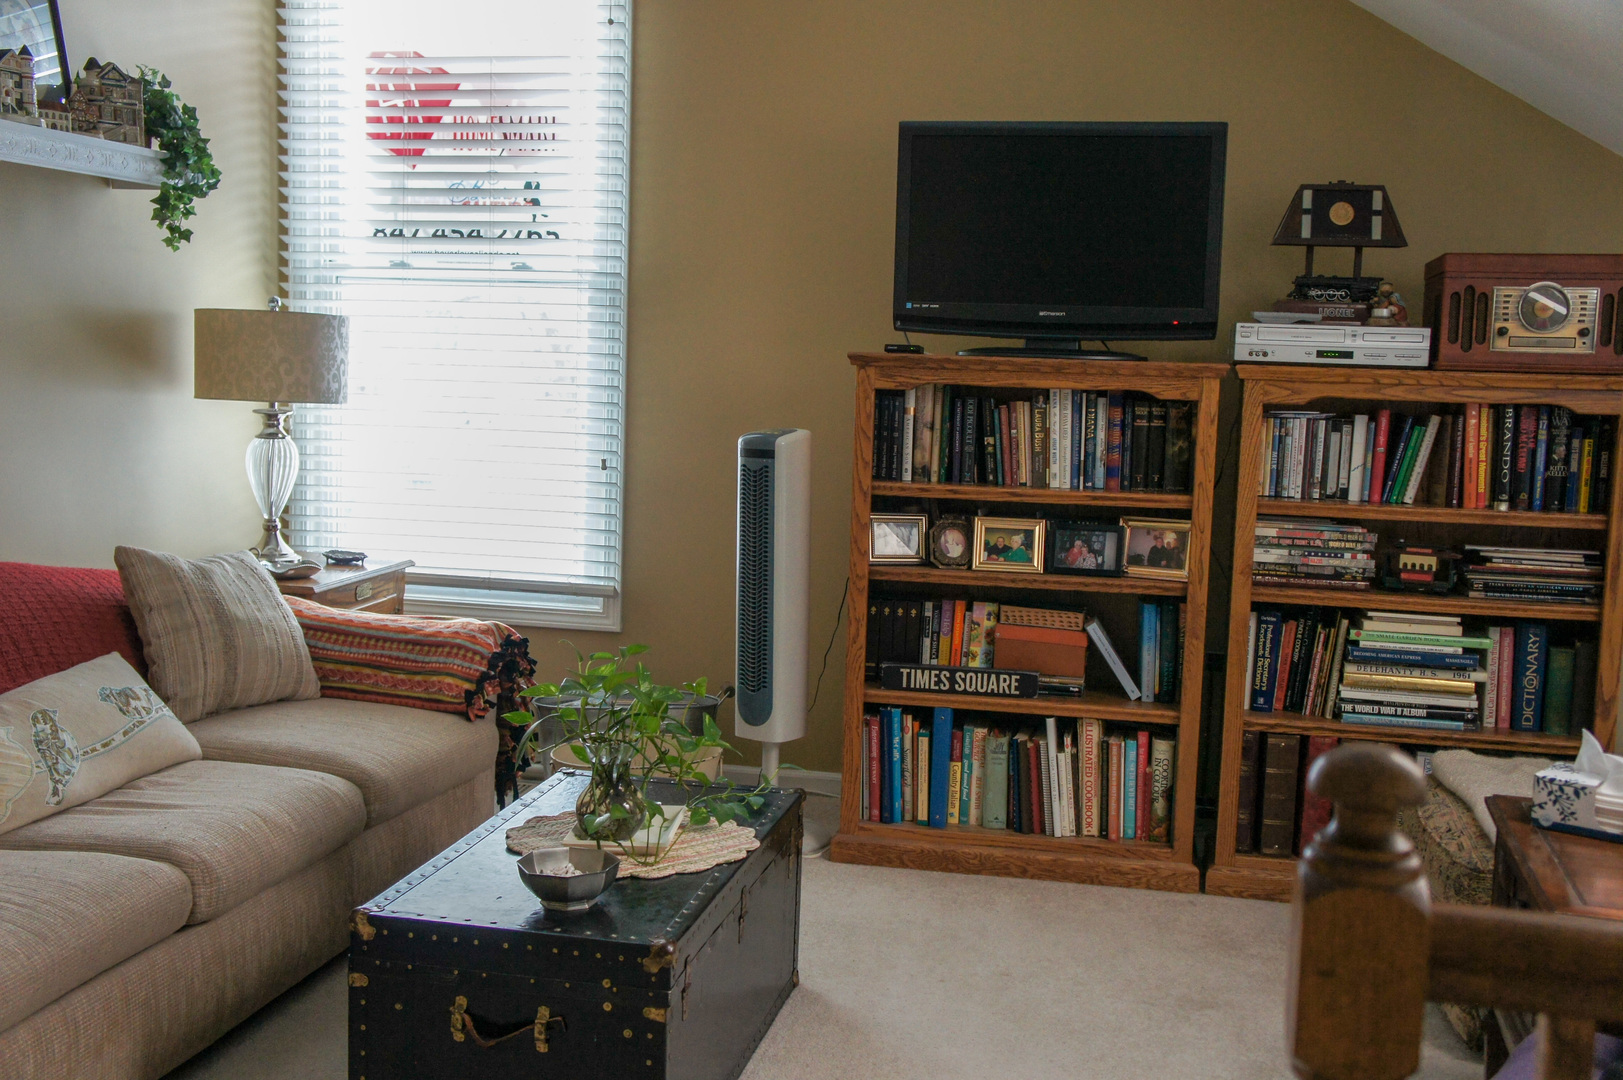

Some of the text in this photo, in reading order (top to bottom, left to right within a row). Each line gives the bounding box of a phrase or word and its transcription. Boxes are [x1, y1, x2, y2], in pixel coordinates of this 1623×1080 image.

[1318, 307, 1355, 317] LIONEL
[965, 416, 974, 444] PICOULT
[1034, 409, 1045, 452] LAURA BUSH
[1086, 409, 1095, 439] DIANA
[1113, 408, 1121, 425] TOM
[1539, 420, 1548, 429] 17
[1112, 427, 1120, 460] BROKAW
[1477, 408, 1488, 493] Baseball's Great Moments
[1501, 408, 1513, 483] BRANDO
[942, 619, 950, 634] Help
[1264, 624, 1273, 657] Professional
[1296, 618, 1305, 639] FONDUE
[1253, 624, 1266, 690] Encyclopedic Dictionary
[1356, 664, 1471, 680] DELEHANTY H. S. 1961
[899, 668, 1021, 695] TIMES SQUARE
[1260, 658, 1271, 691] Secretary's
[1487, 669, 1497, 695] Negotiate
[1521, 633, 1540, 726] DICTIONARY
[1341, 704, 1427, 717] THE WORLD WAR II ALBUM
[951, 764, 959, 790] Country
[1085, 722, 1093, 828] ILLUSTRATED COOKBOOK
[1152, 757, 1162, 804] IN COLOUR
[1160, 758, 1170, 799] COOKING
[974, 776, 983, 810] JEFF SMITH
